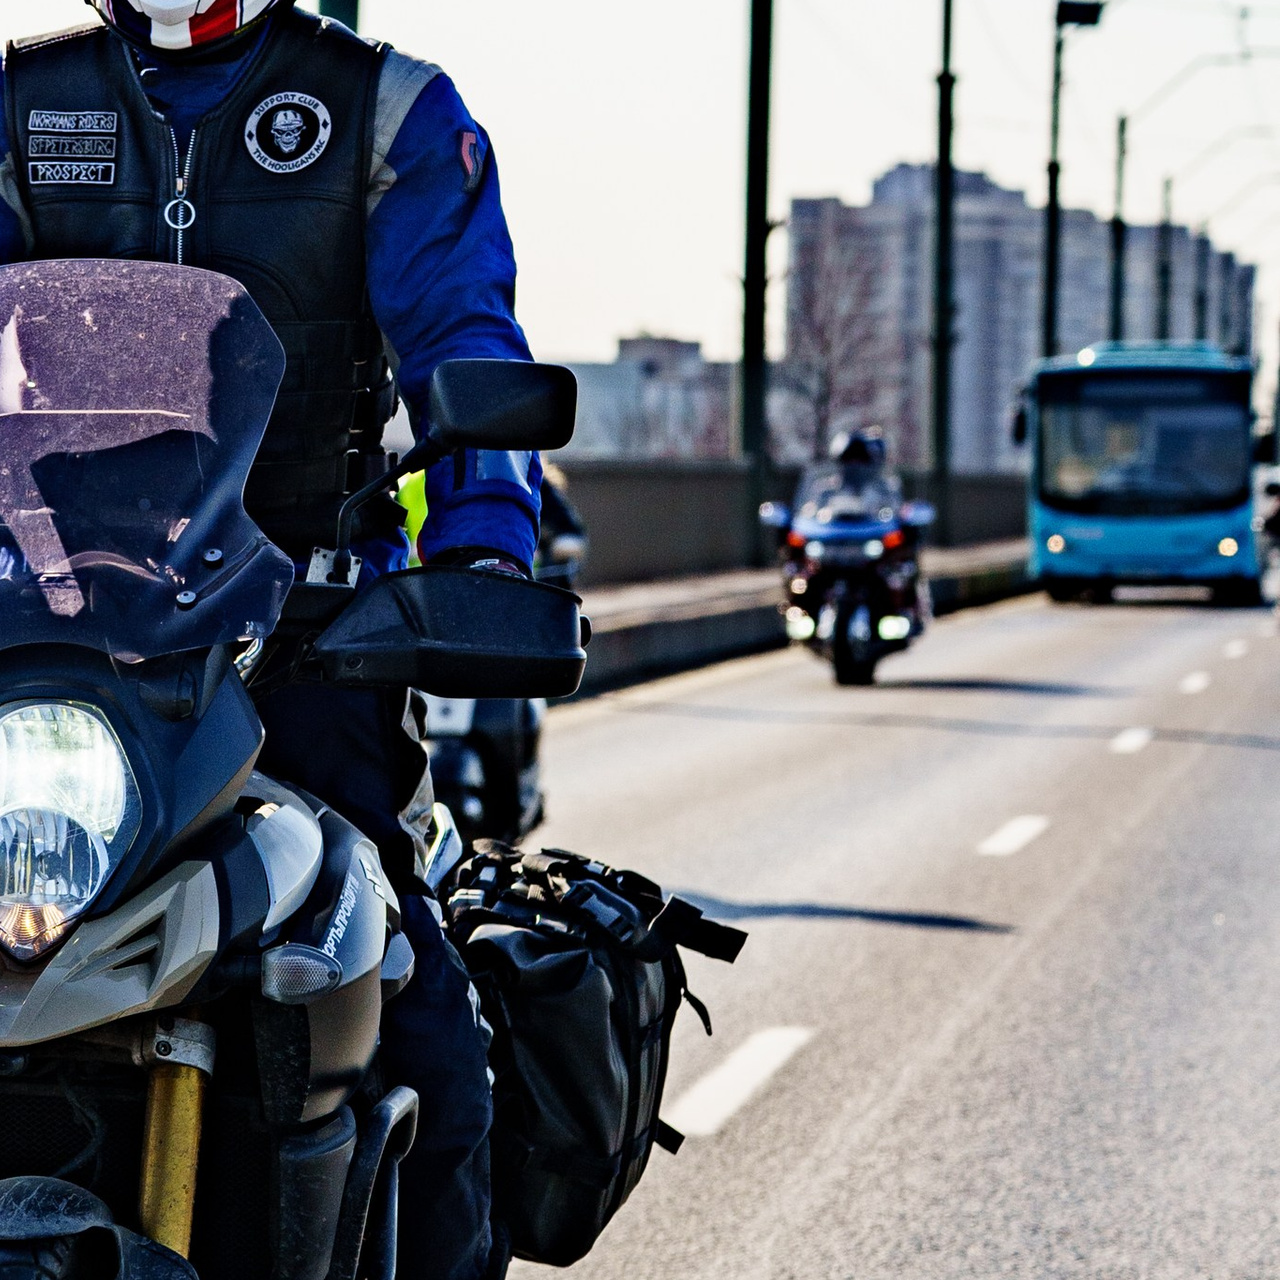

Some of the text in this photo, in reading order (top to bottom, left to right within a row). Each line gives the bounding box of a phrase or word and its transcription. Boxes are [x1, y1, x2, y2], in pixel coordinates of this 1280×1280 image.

[254, 93, 320, 117] SUPPORT CLUB
[32, 113, 114, 129] NORMANS RIDERS
[253, 138, 326, 171] THE HOOLIGANS MC
[37, 165, 105, 181] PROSPECT
